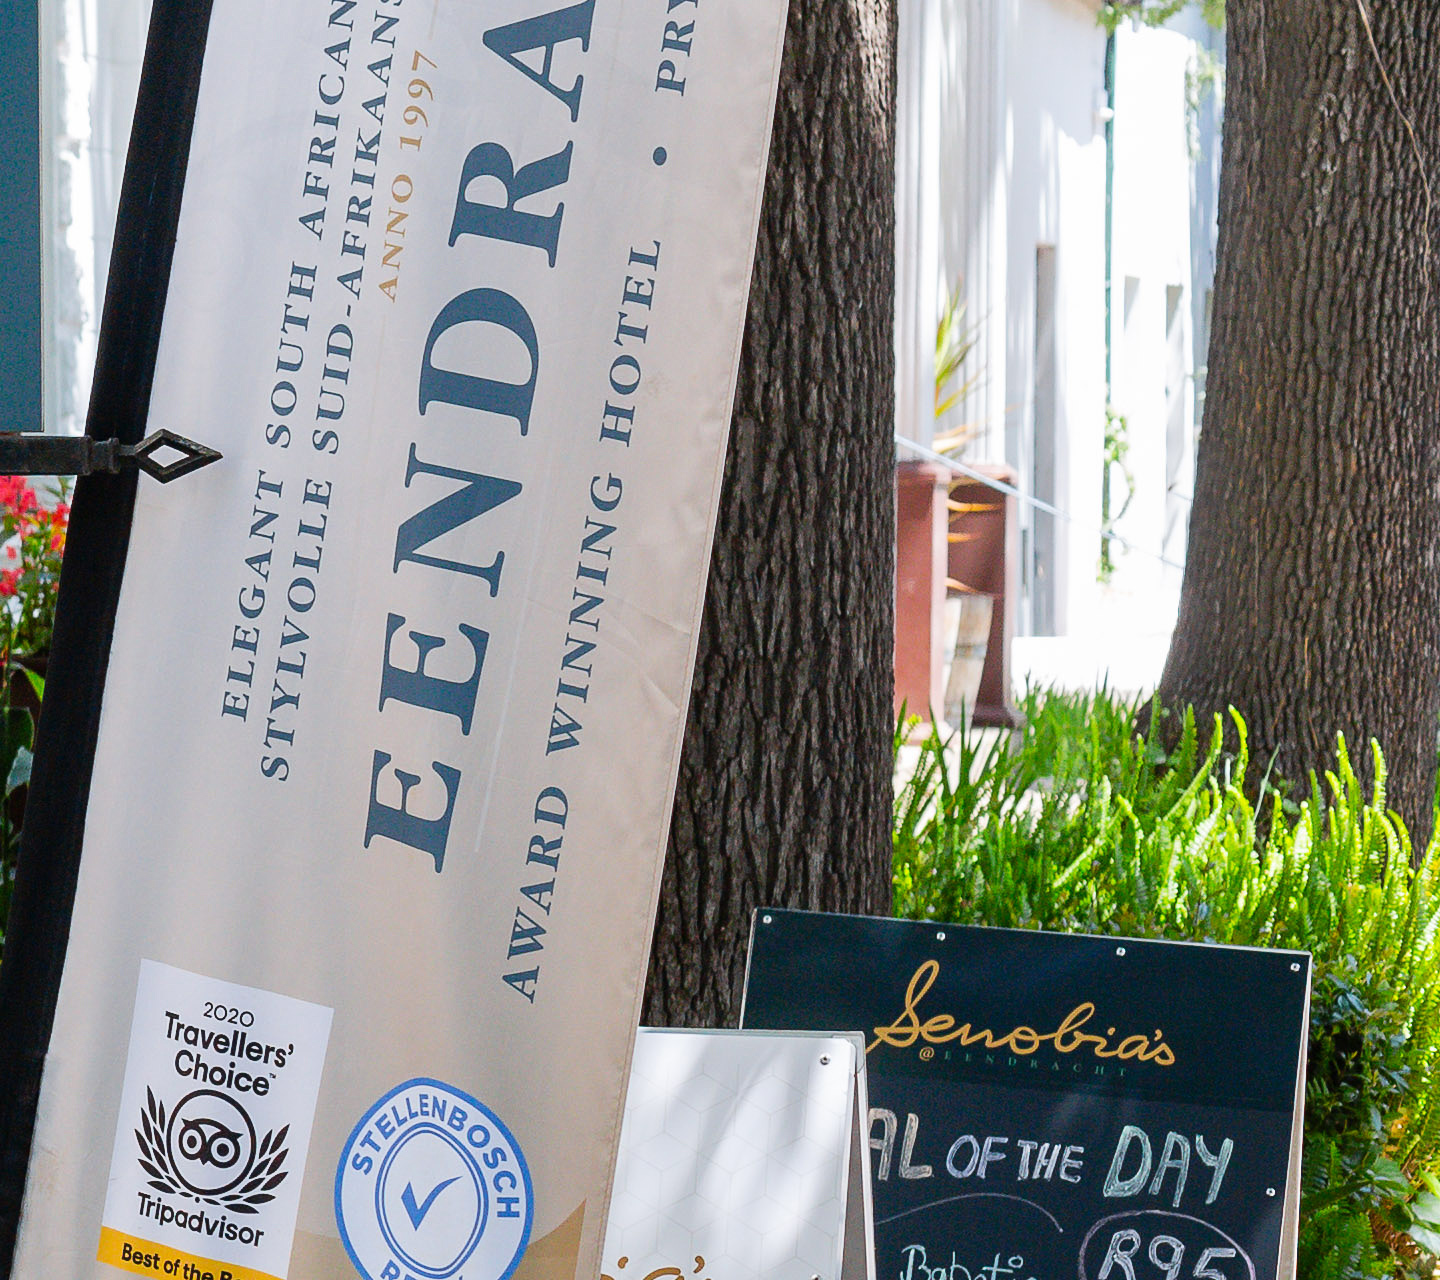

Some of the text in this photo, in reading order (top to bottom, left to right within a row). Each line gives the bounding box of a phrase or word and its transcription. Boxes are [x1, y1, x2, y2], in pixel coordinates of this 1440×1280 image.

[379, 50, 436, 302] ANNO 1997
[222, 470, 283, 722] ELEGANT
[266, 261, 317, 448] SOUTH
[261, 479, 332, 781] STYLVOLLE
[502, 240, 660, 1004] AWARD WINNING HOTEL
[204, 1002, 254, 1027] 2020
[944, 1050, 1127, 1077] EENDRACHT
[351, 1094, 520, 1218] STELLENBOSCH
[946, 1134, 1009, 1180] OF
[1017, 1139, 1084, 1183] THE
[1103, 1125, 1234, 1207] DAY
[122, 1243, 160, 1269] Best
[164, 1259, 180, 1275] of
[138, 1192, 264, 1246] Tripadvisor
